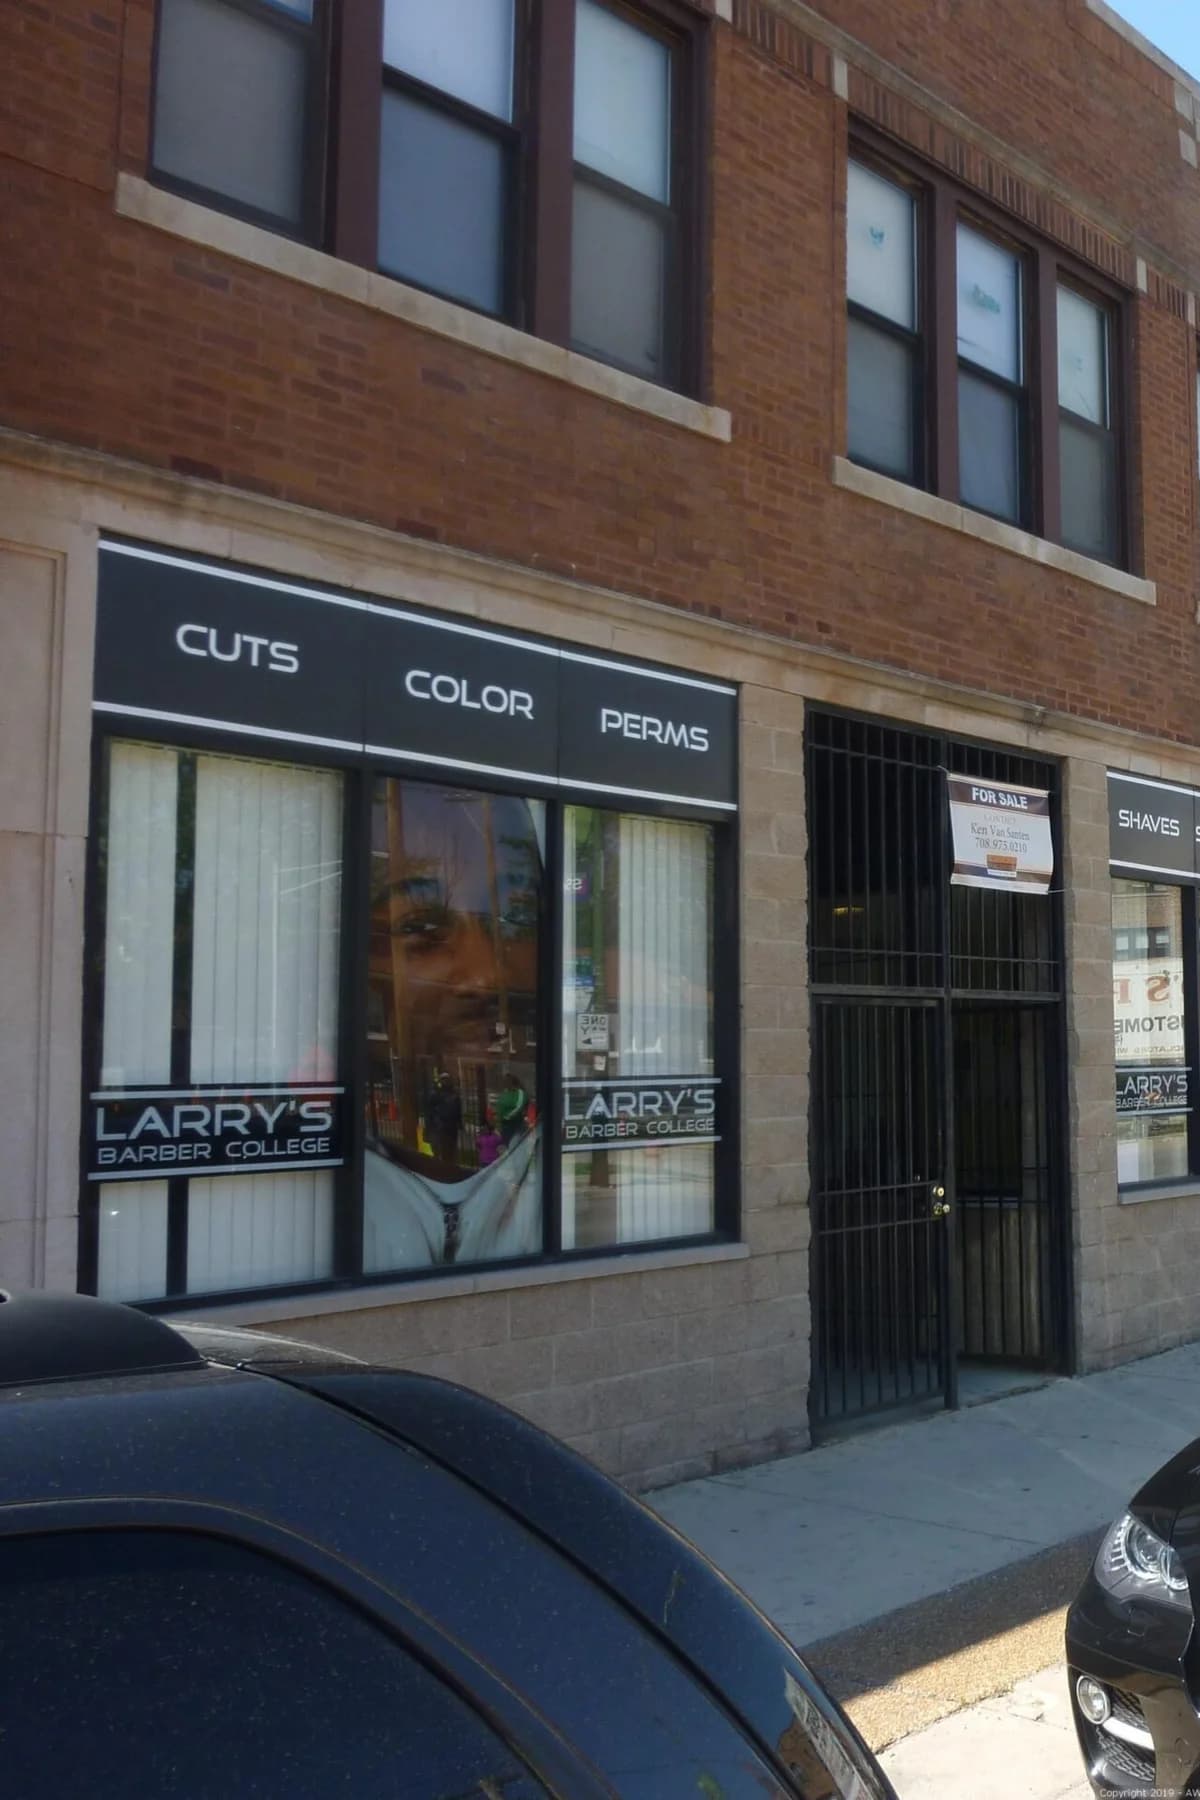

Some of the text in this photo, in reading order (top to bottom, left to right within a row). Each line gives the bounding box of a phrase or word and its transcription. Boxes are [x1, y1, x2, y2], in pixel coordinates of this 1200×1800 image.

[176, 623, 299, 674] CUTS
[405, 670, 534, 720] COLOR
[600, 708, 709, 752] PERMS
[971, 786, 1028, 809] FOR SALE
[970, 821, 988, 835] Ken
[989, 824, 1006, 837] Van
[1118, 809, 1180, 837] SHAVES
[564, 1088, 716, 1121] LARRY'S
[95, 1100, 333, 1142] LARRY'S
[566, 1117, 715, 1140] BARBER COLLEGE
[98, 1136, 330, 1165] BARBER COLLEGE
